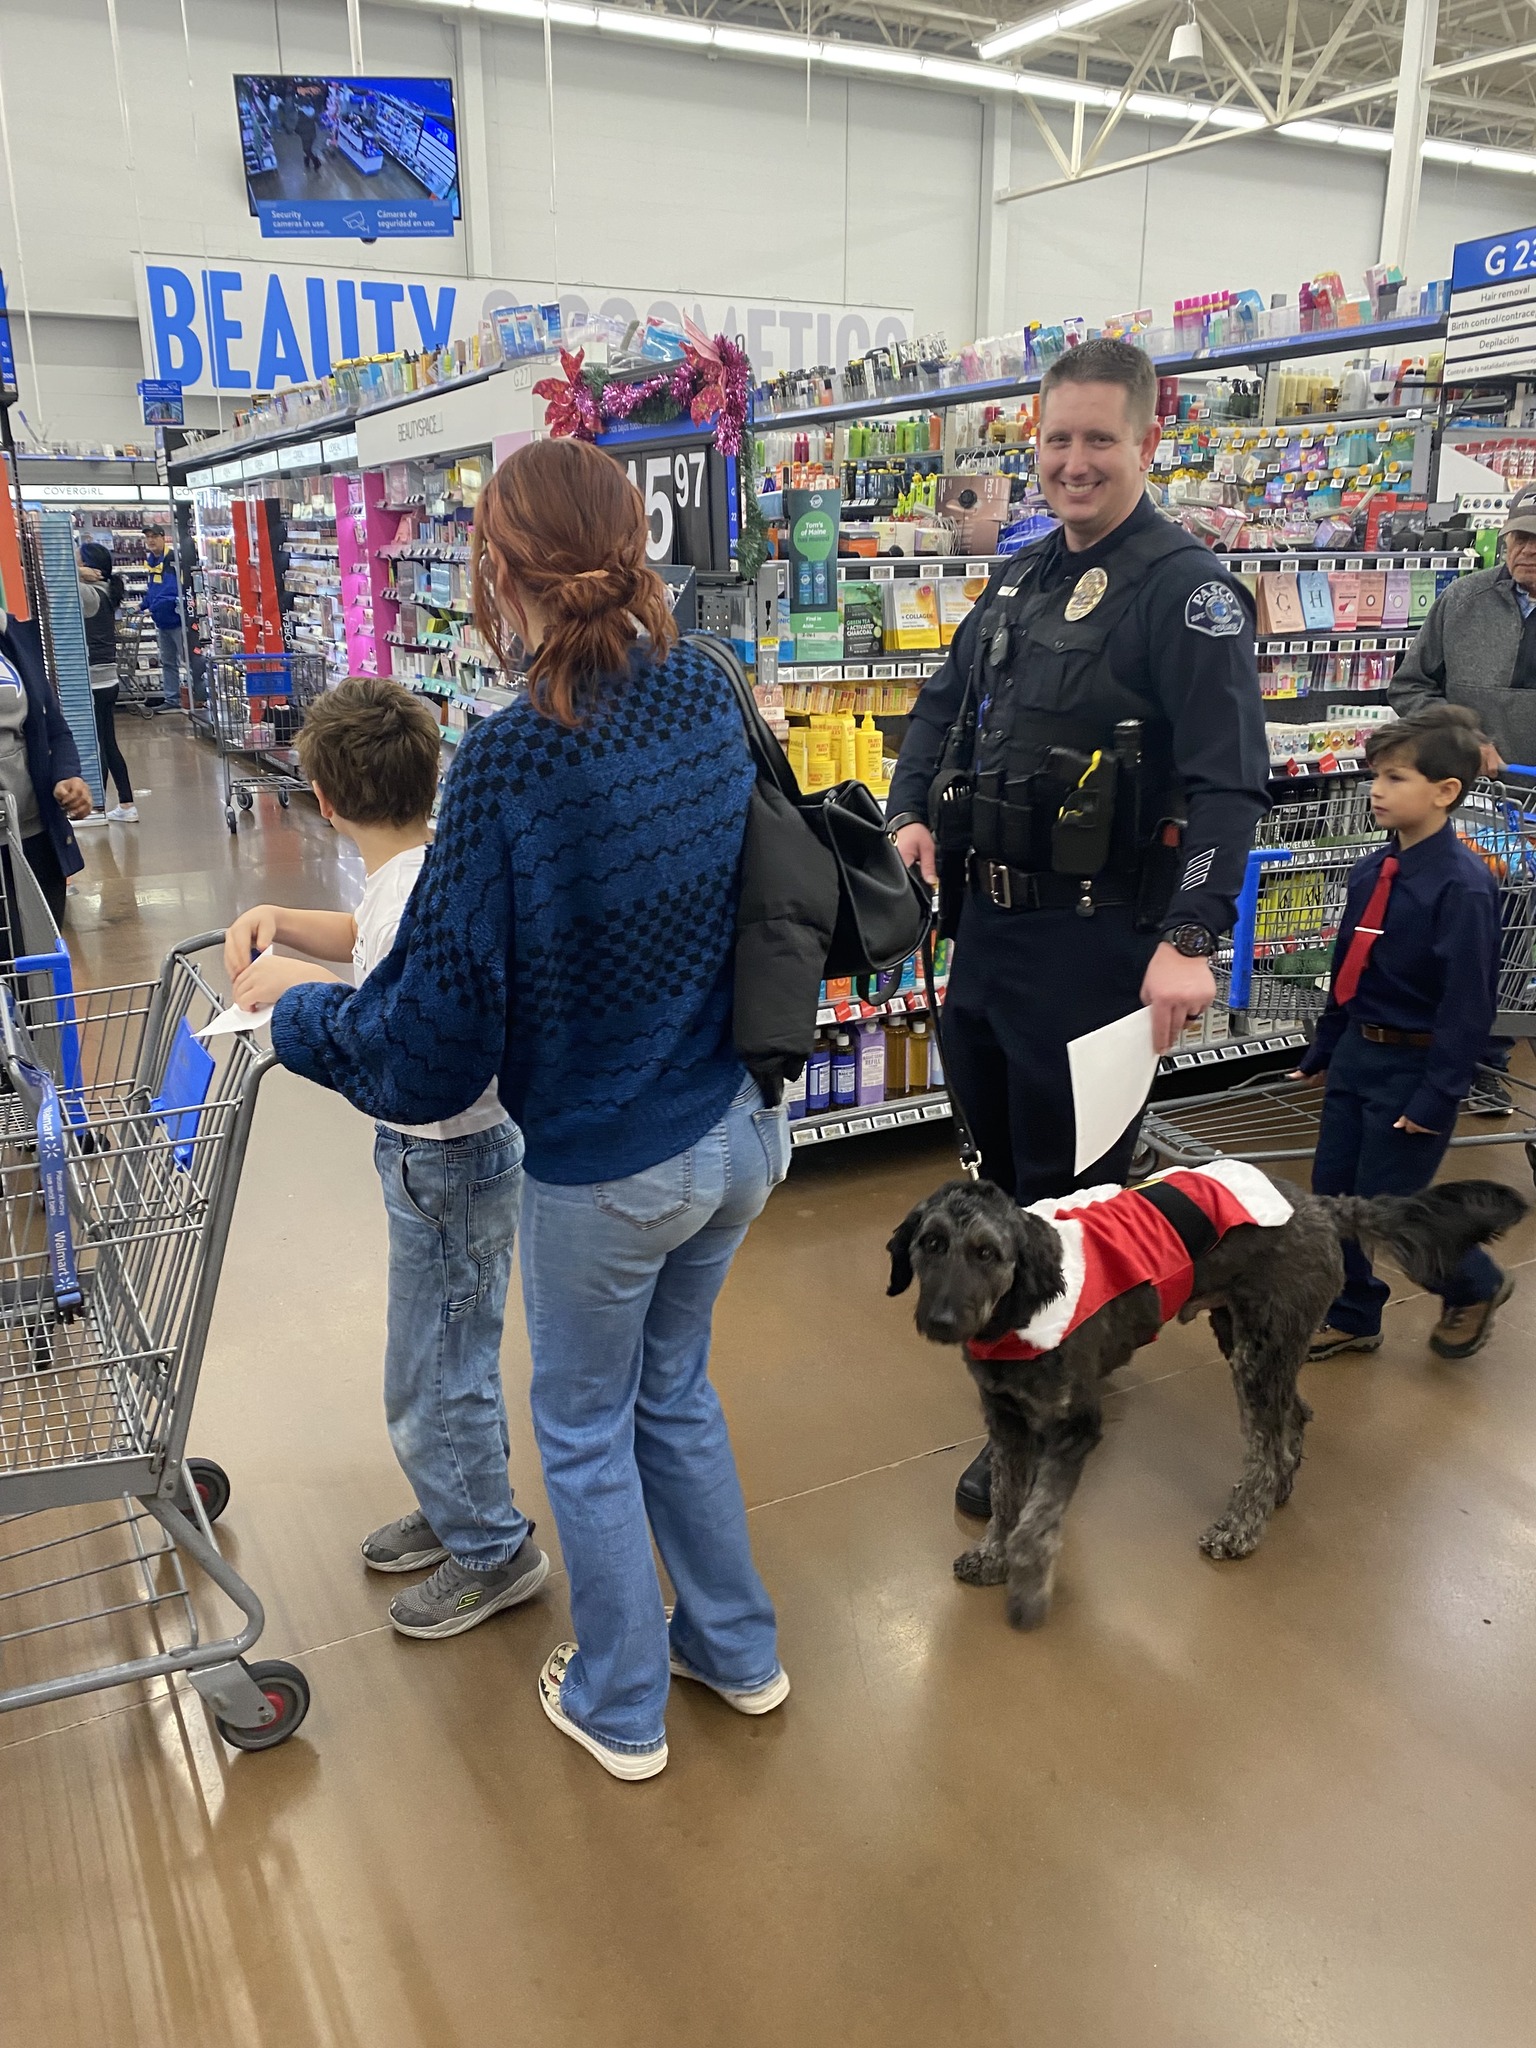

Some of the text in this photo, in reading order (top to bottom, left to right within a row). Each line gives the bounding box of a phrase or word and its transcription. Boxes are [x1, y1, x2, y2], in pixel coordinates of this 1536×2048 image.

[271, 210, 301, 220] Security
[376, 209, 418, 219] Cámaras de
[272, 220, 302, 228] cameras
[377, 219, 412, 229] seguridad
[413, 220, 423, 228] en
[1485, 245, 1506, 276] G
[1480, 284, 1531, 303] Hair removal
[146, 265, 457, 390] BEAUTY
[1451, 320, 1470, 332] Birth
[1479, 336, 1520, 350] Depilación
[513, 367, 529, 388] G27
[1446, 367, 1467, 377] Control
[43, 487, 104, 496] COVERGIRL
[805, 521, 824, 529] Tom's
[800, 528, 827, 537] of Maine
[1191, 583, 1234, 607] PASCO
[243, 612, 252, 627] LIP
[264, 620, 274, 636] LIP
[42, 1104, 57, 1142] Walmart
[54, 1230, 70, 1277] Walmart
